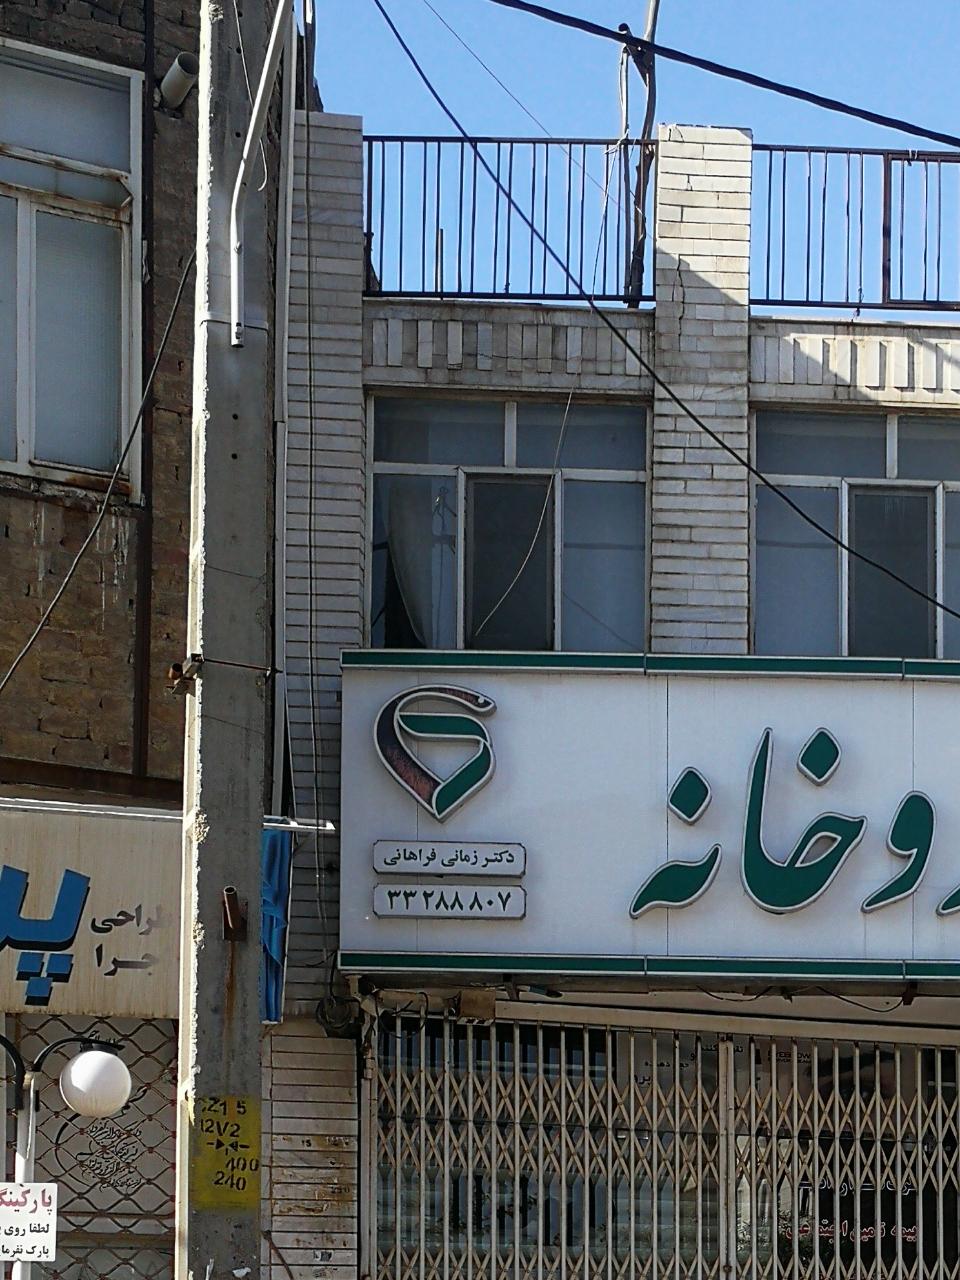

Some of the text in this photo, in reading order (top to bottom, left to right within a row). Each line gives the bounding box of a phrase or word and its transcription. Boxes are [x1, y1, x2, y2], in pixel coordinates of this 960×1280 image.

[383, 848, 515, 868] دکتر زمانی فراهانی
[213, 1170, 247, 1191] 240
[4, 1223, 50, 1237] لطفا روی
[26, 1245, 49, 1258] پارک
